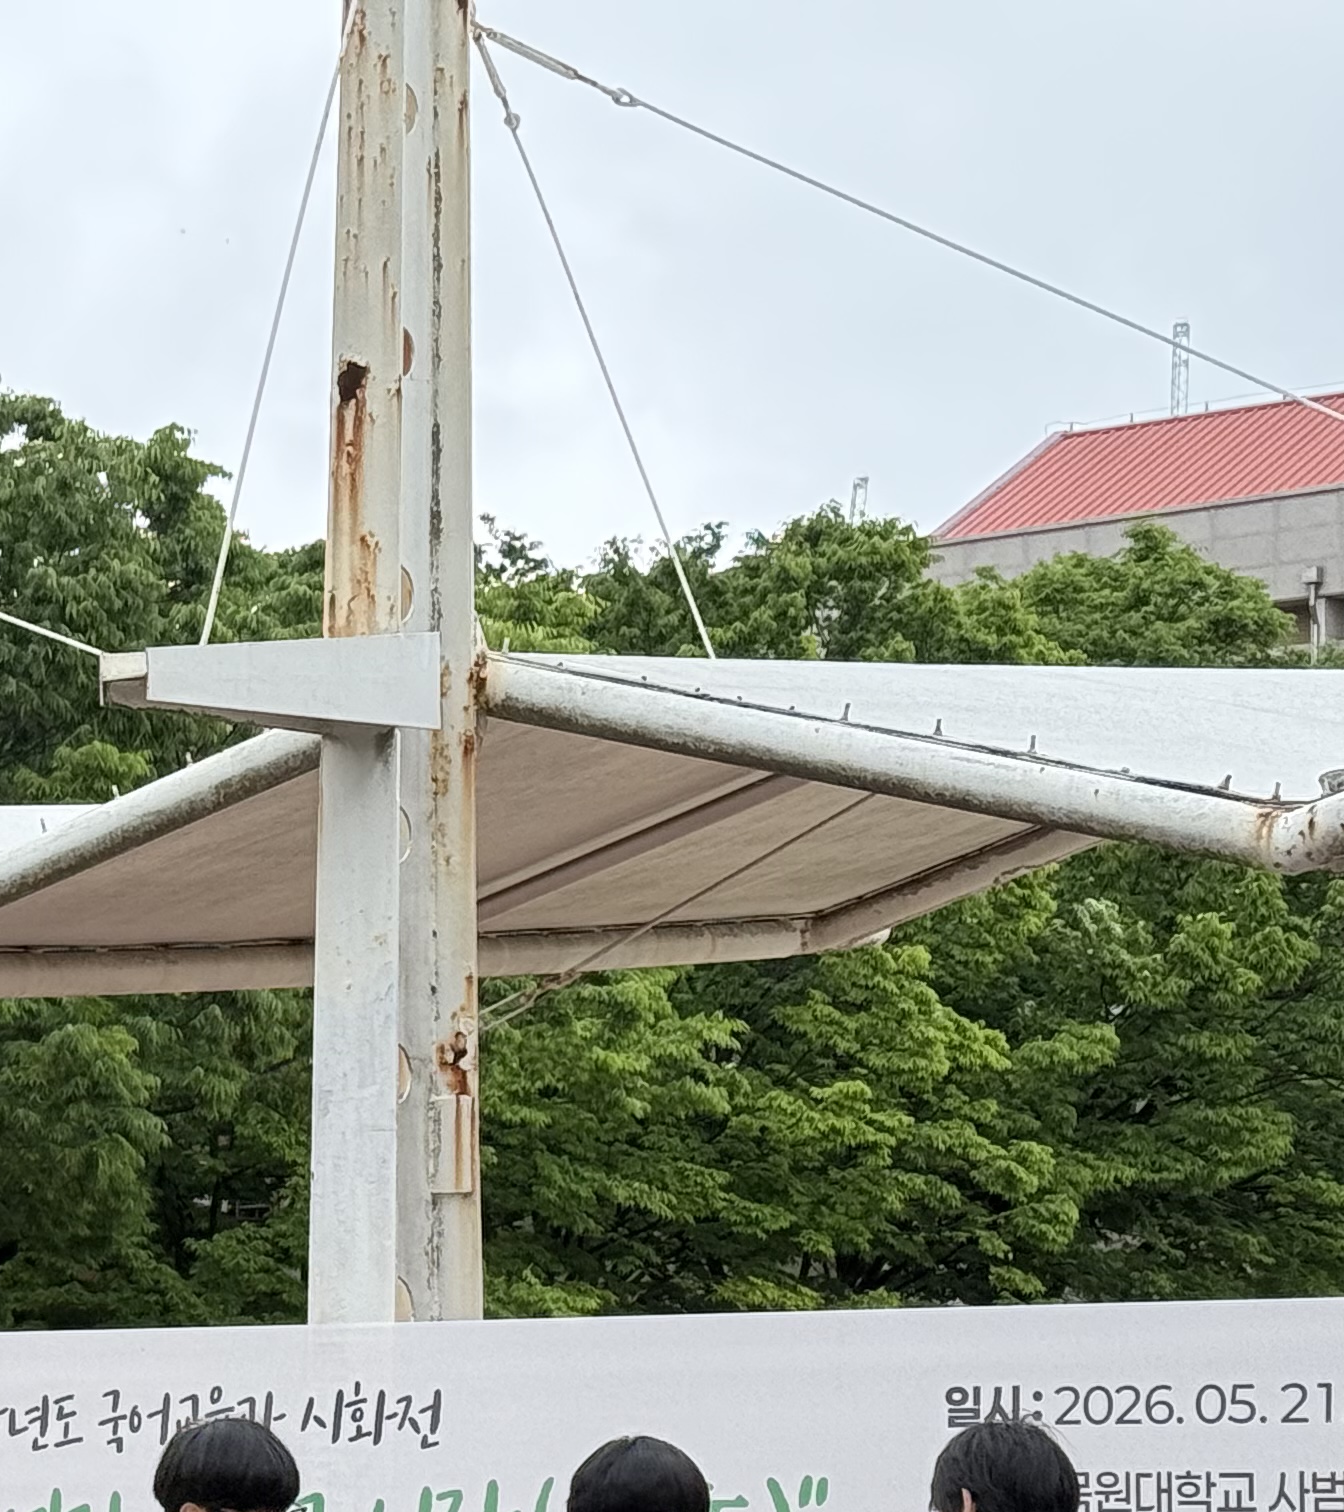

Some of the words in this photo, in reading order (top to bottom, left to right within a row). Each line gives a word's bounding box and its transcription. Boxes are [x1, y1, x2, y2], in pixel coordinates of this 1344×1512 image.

[300, 1381, 443, 1449] 시화전
[1195, 1383, 1268, 1425] 05.
[1280, 1382, 1333, 1424] 21
